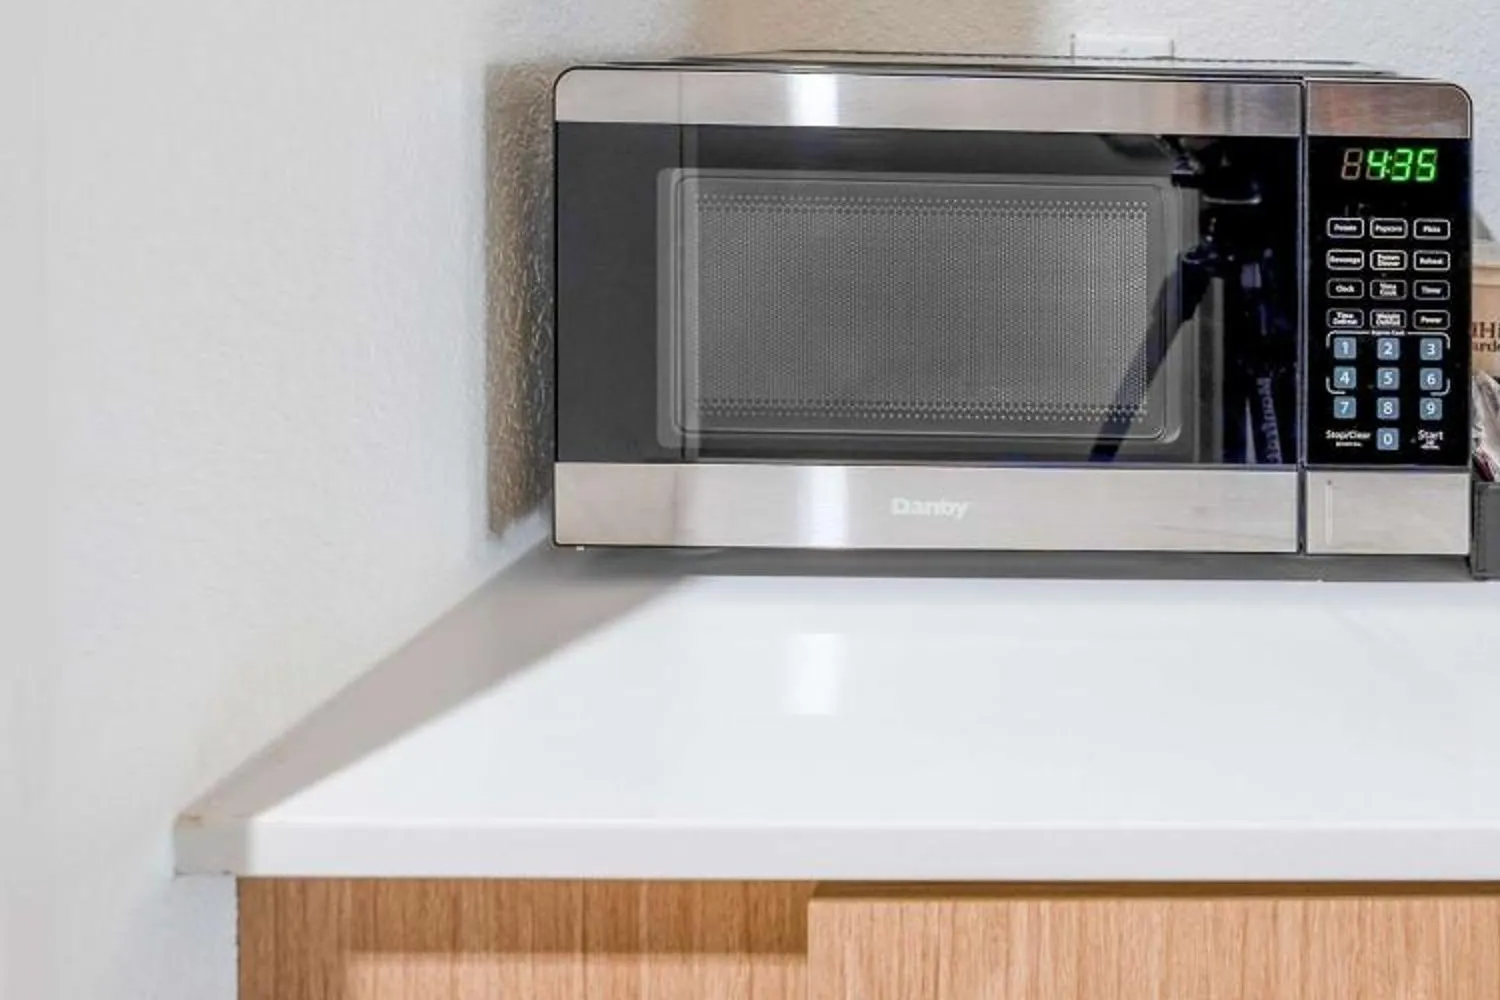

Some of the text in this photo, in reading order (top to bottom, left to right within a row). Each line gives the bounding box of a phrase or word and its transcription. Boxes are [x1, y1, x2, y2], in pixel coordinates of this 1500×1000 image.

[1366, 148, 1438, 182] 4:35
[1341, 341, 1349, 355] 1
[1383, 342, 1393, 355] 2
[1427, 343, 1436, 356] 3
[1339, 371, 1350, 385] 4
[1383, 371, 1393, 385] 5
[1426, 372, 1436, 385] 6
[1339, 401, 1349, 415] 7
[1383, 401, 1393, 415] 8
[1426, 401, 1436, 415] 9
[1326, 429, 1371, 440] Stop/Clear
[1383, 433, 1393, 446] 0
[1417, 429, 1443, 441] Start
[890, 497, 971, 520] Danby
